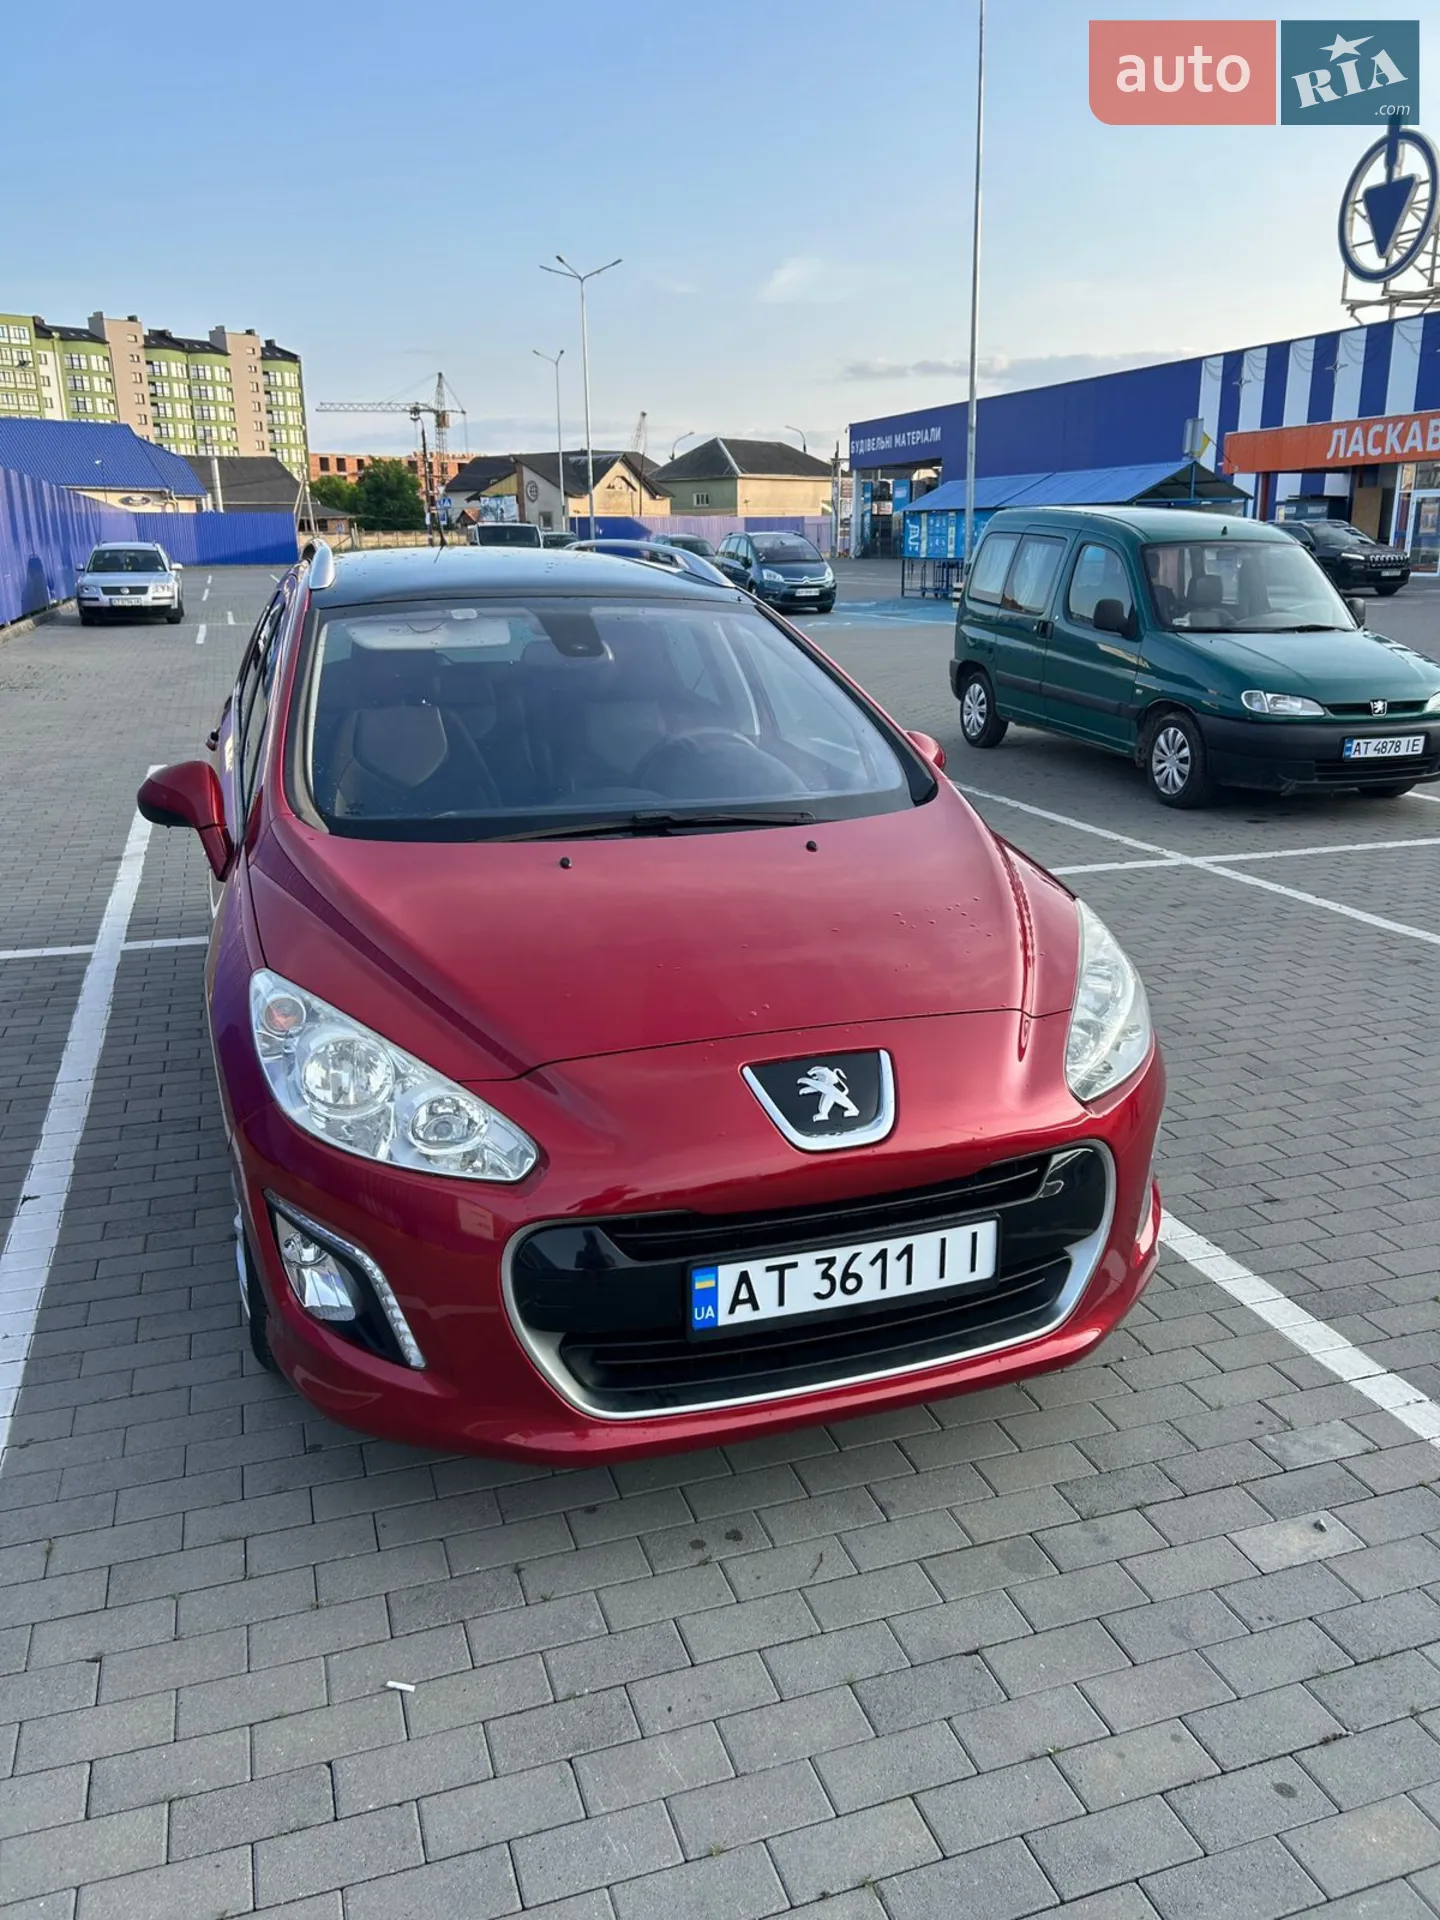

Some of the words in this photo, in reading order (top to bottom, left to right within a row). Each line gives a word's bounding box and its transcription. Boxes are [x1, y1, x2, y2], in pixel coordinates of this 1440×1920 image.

[851, 435, 893, 455] БУДІВЕЛЬНІ
[894, 427, 942, 448] МАТЕРІАЛИ
[1353, 741, 1371, 756] AT
[1373, 740, 1402, 755] 4878
[728, 1261, 799, 1315] AT
[813, 1242, 914, 1301] 3611
[694, 1306, 716, 1321] UA
